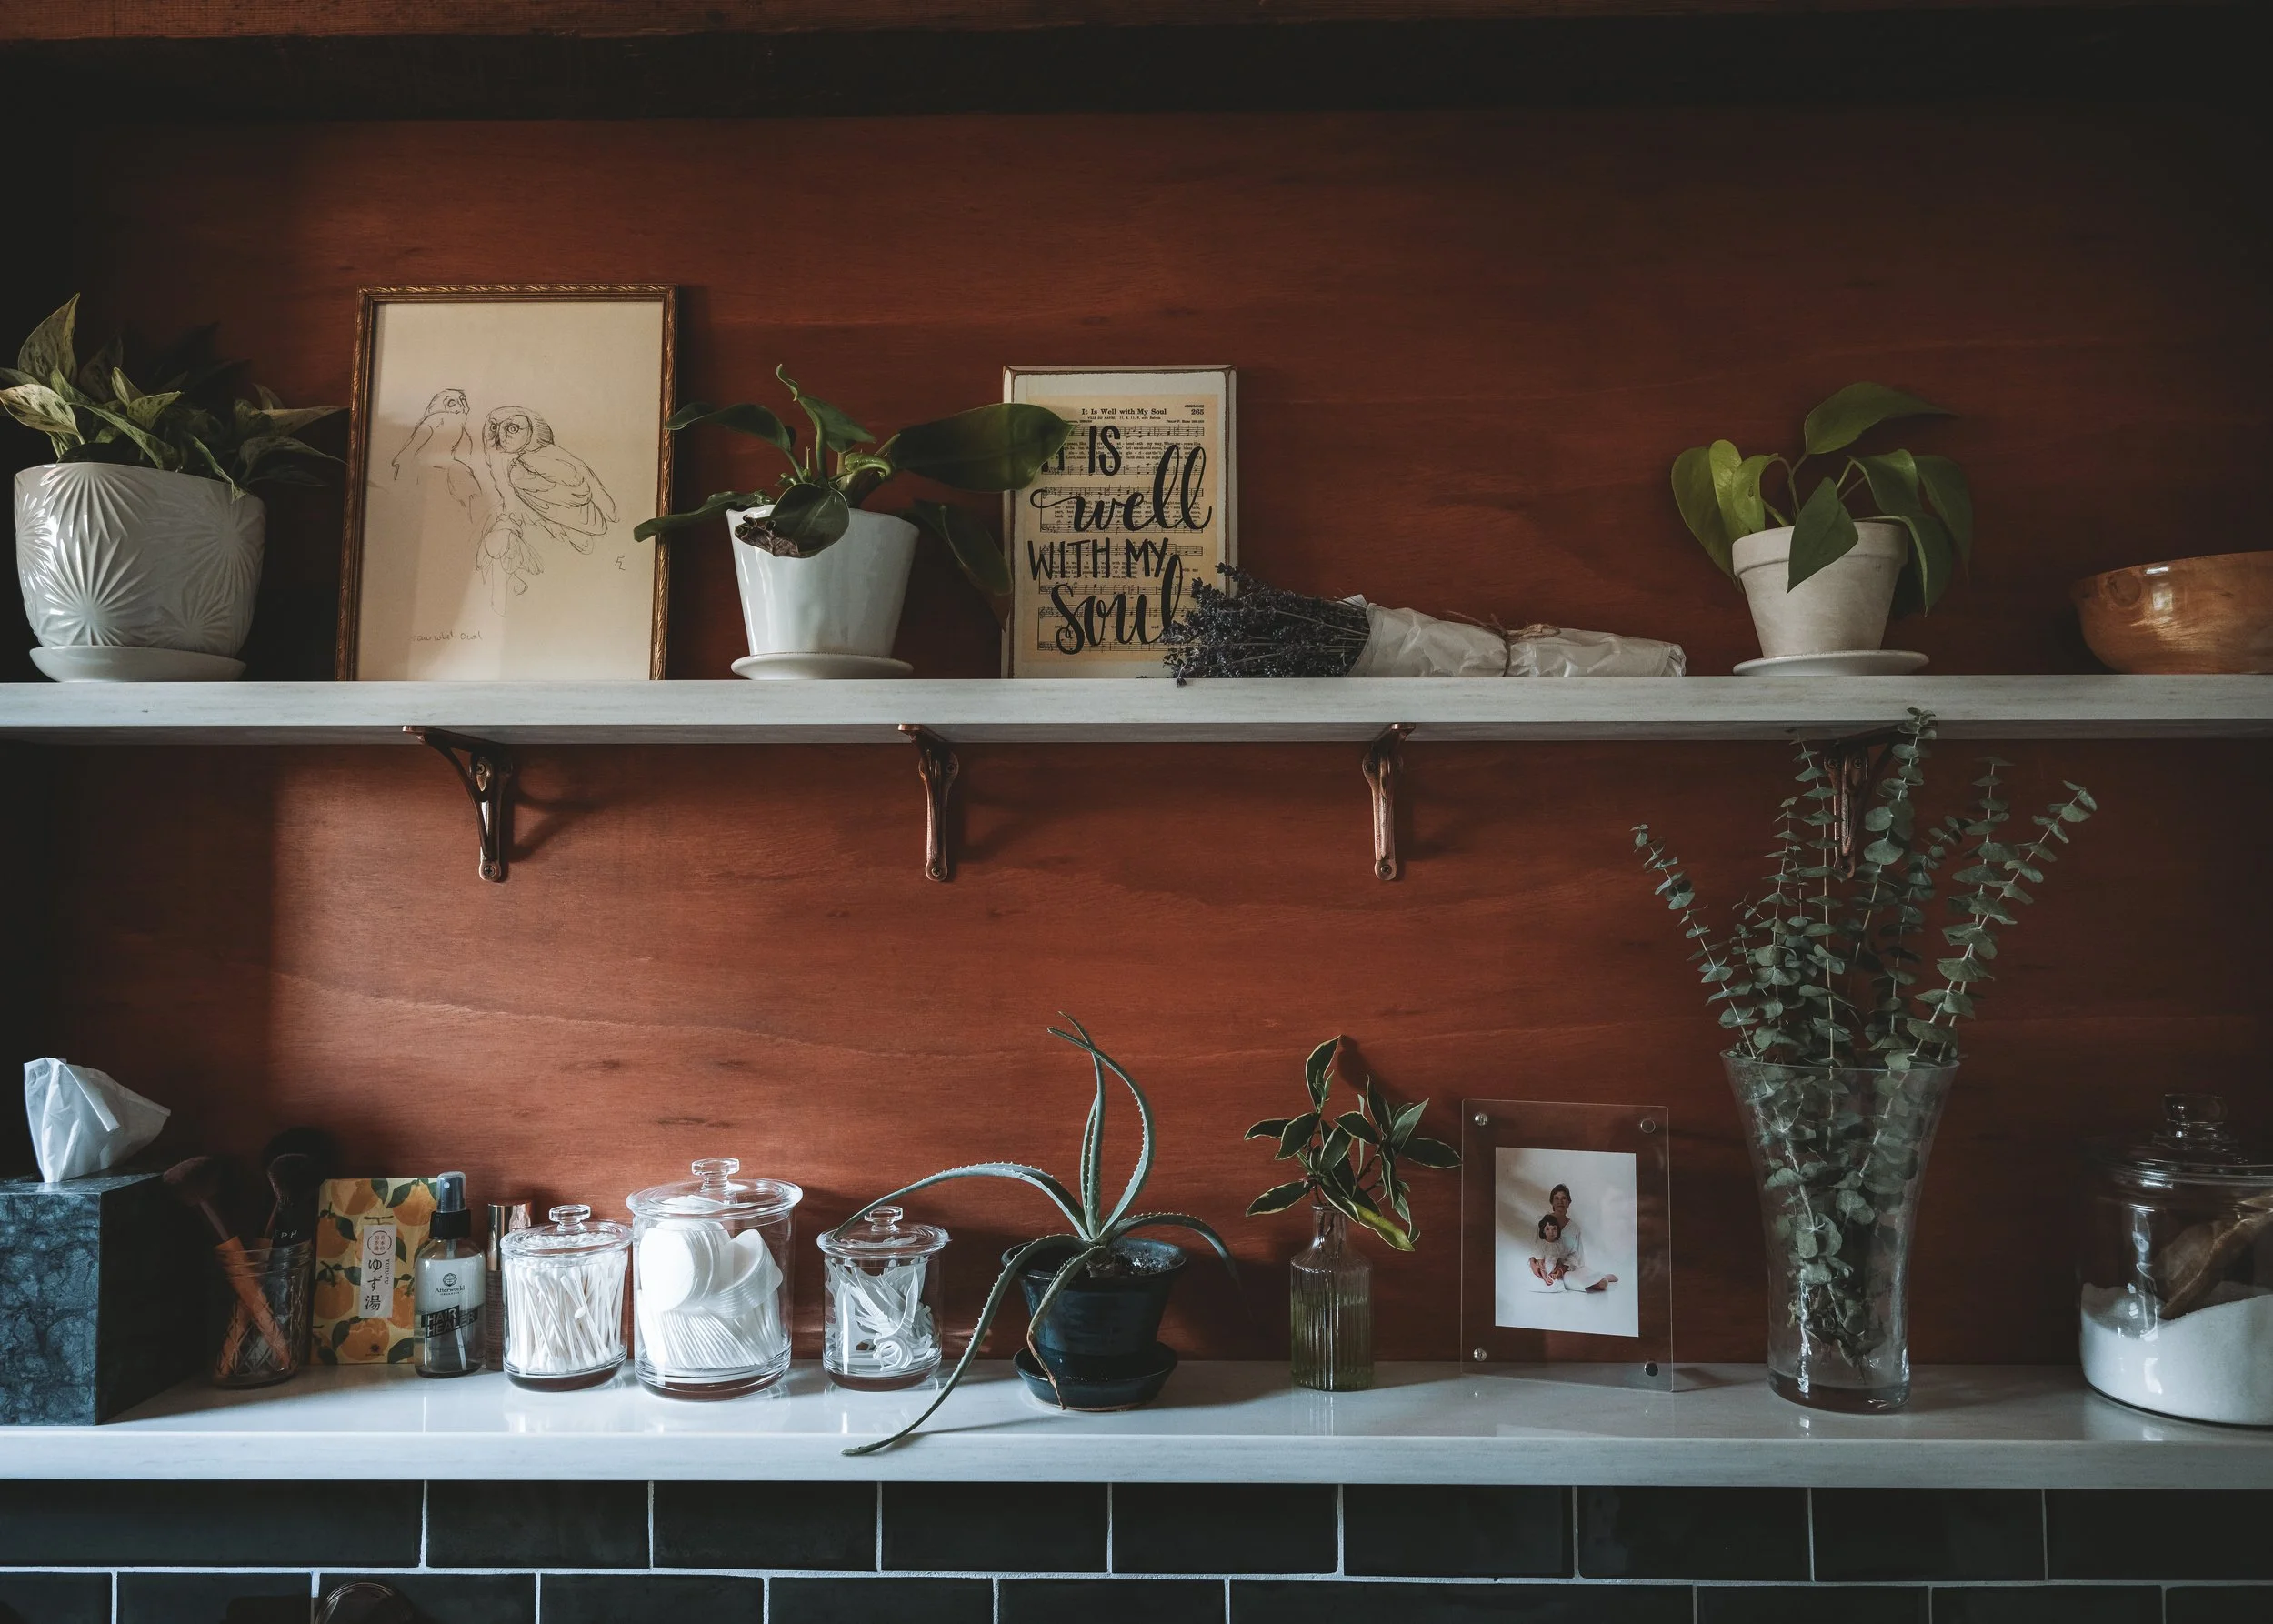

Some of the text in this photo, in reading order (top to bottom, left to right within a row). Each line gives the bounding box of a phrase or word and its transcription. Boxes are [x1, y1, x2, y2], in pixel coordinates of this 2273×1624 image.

[1136, 408, 1149, 416] My
[1088, 425, 1121, 476] IS
[1029, 444, 1212, 531] well
[1027, 537, 1169, 581] WITH MY
[1050, 554, 1182, 655] Soul
[365, 1258, 383, 1311] ゆず湯
[435, 1284, 466, 1293] Afterworld
[427, 1308, 456, 1326] HAIR
[427, 1311, 476, 1337] HEALER
